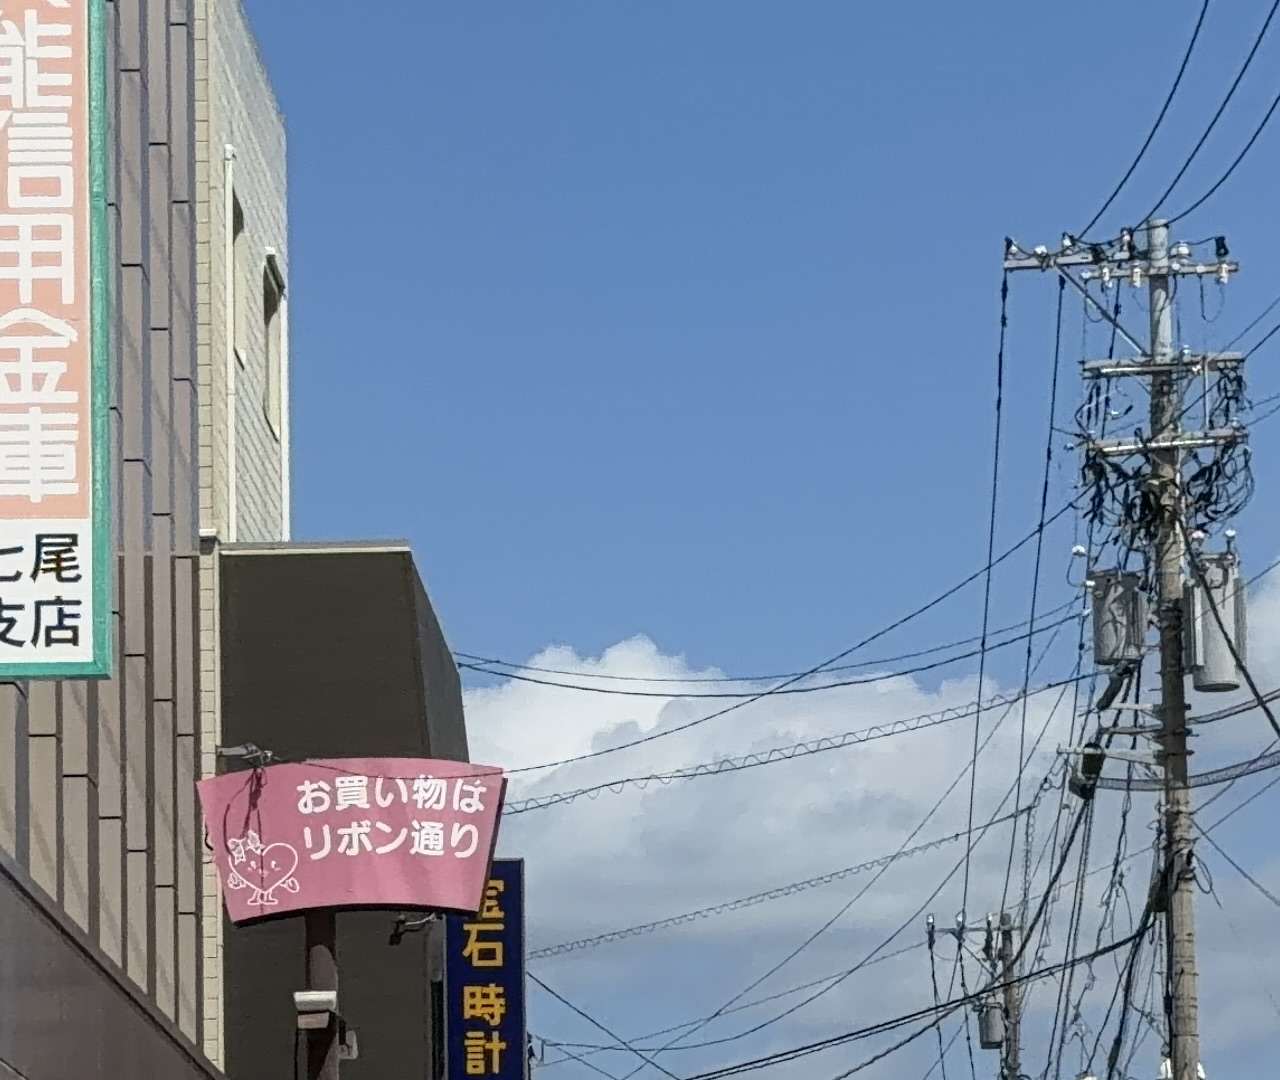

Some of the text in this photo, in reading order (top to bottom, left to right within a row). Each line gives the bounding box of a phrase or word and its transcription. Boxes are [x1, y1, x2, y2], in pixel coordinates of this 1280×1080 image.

[296, 775, 488, 815] お買い物は
[303, 819, 481, 860] リボン通り
[463, 984, 507, 1075] 時計
